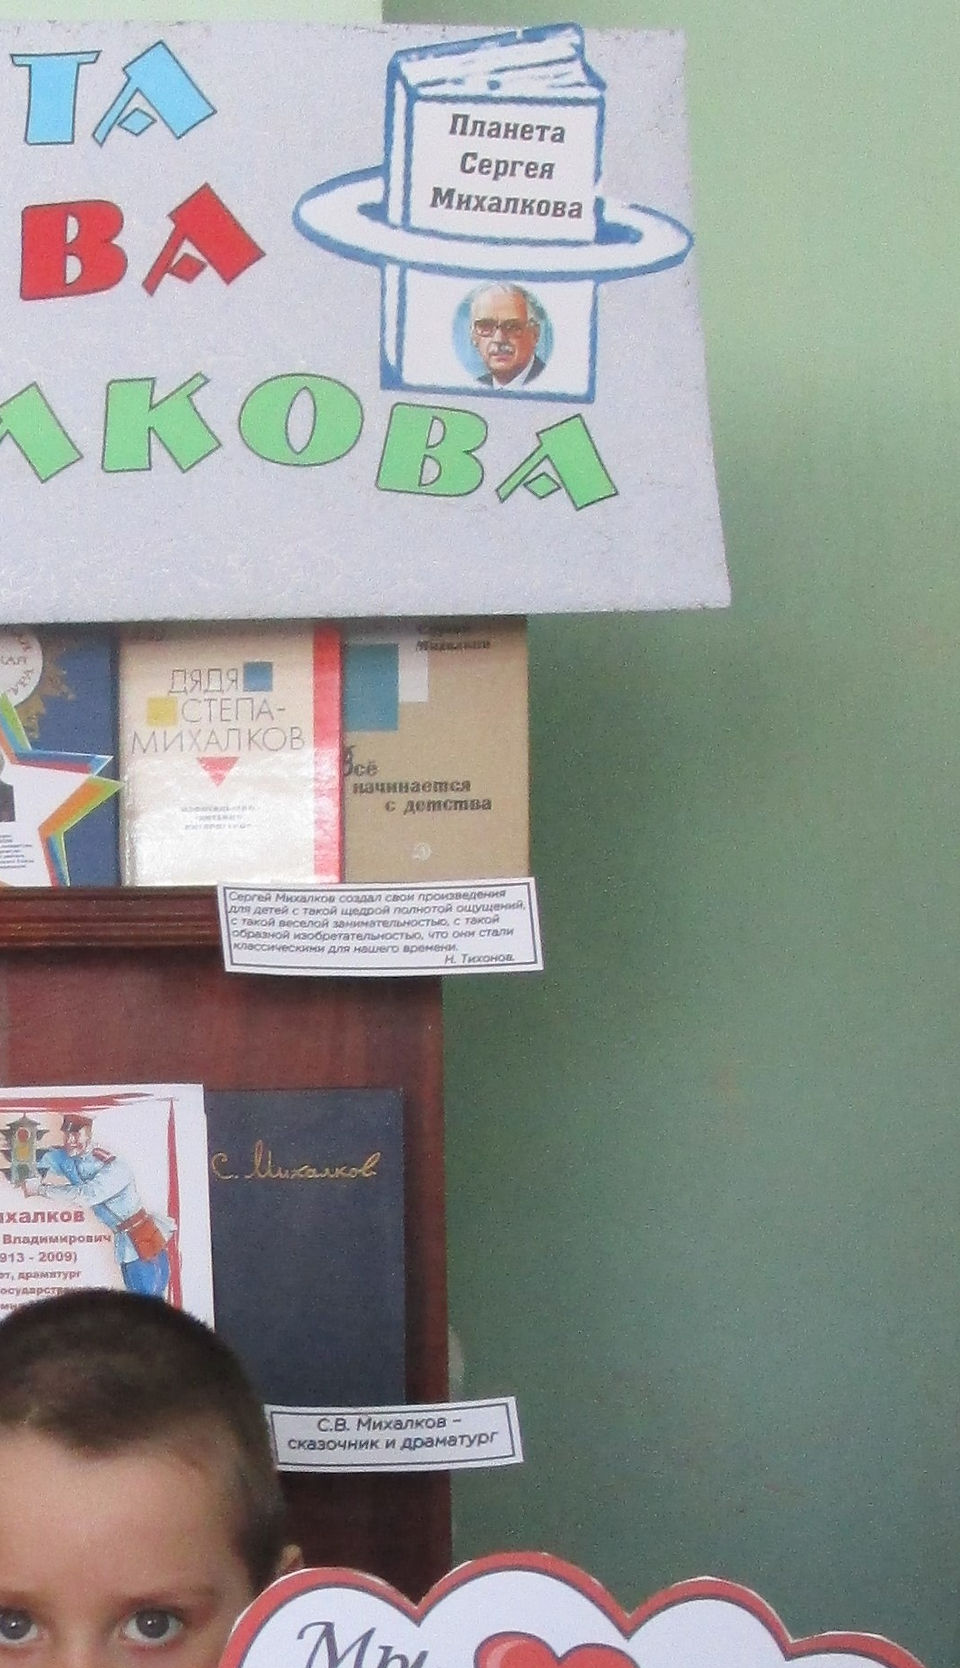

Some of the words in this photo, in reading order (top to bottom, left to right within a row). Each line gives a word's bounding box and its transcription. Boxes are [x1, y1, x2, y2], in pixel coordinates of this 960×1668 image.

[449, 113, 566, 144] Планета
[459, 152, 556, 182] Сергея
[429, 187, 584, 220] Михалкова
[168, 668, 239, 695] ДЯДЯ
[181, 698, 286, 724] СТЕПА-
[131, 726, 306, 755] МИХАЛКОВ
[352, 779, 471, 795] начинается
[385, 800, 396, 812] с
[403, 798, 492, 816] детства
[212, 1152, 239, 1181] С.
[244, 1140, 381, 1182] Михалков
[2, 1233, 111, 1247] Владимирович
[39, 1251, 78, 1264] 2009)
[18, 1269, 82, 1281] драматург
[317, 1418, 350, 1432] С.В.
[357, 1416, 447, 1432] Михалков
[287, 1437, 380, 1450] сказочник
[385, 1438, 396, 1449] и
[400, 1431, 499, 1450] драматург
